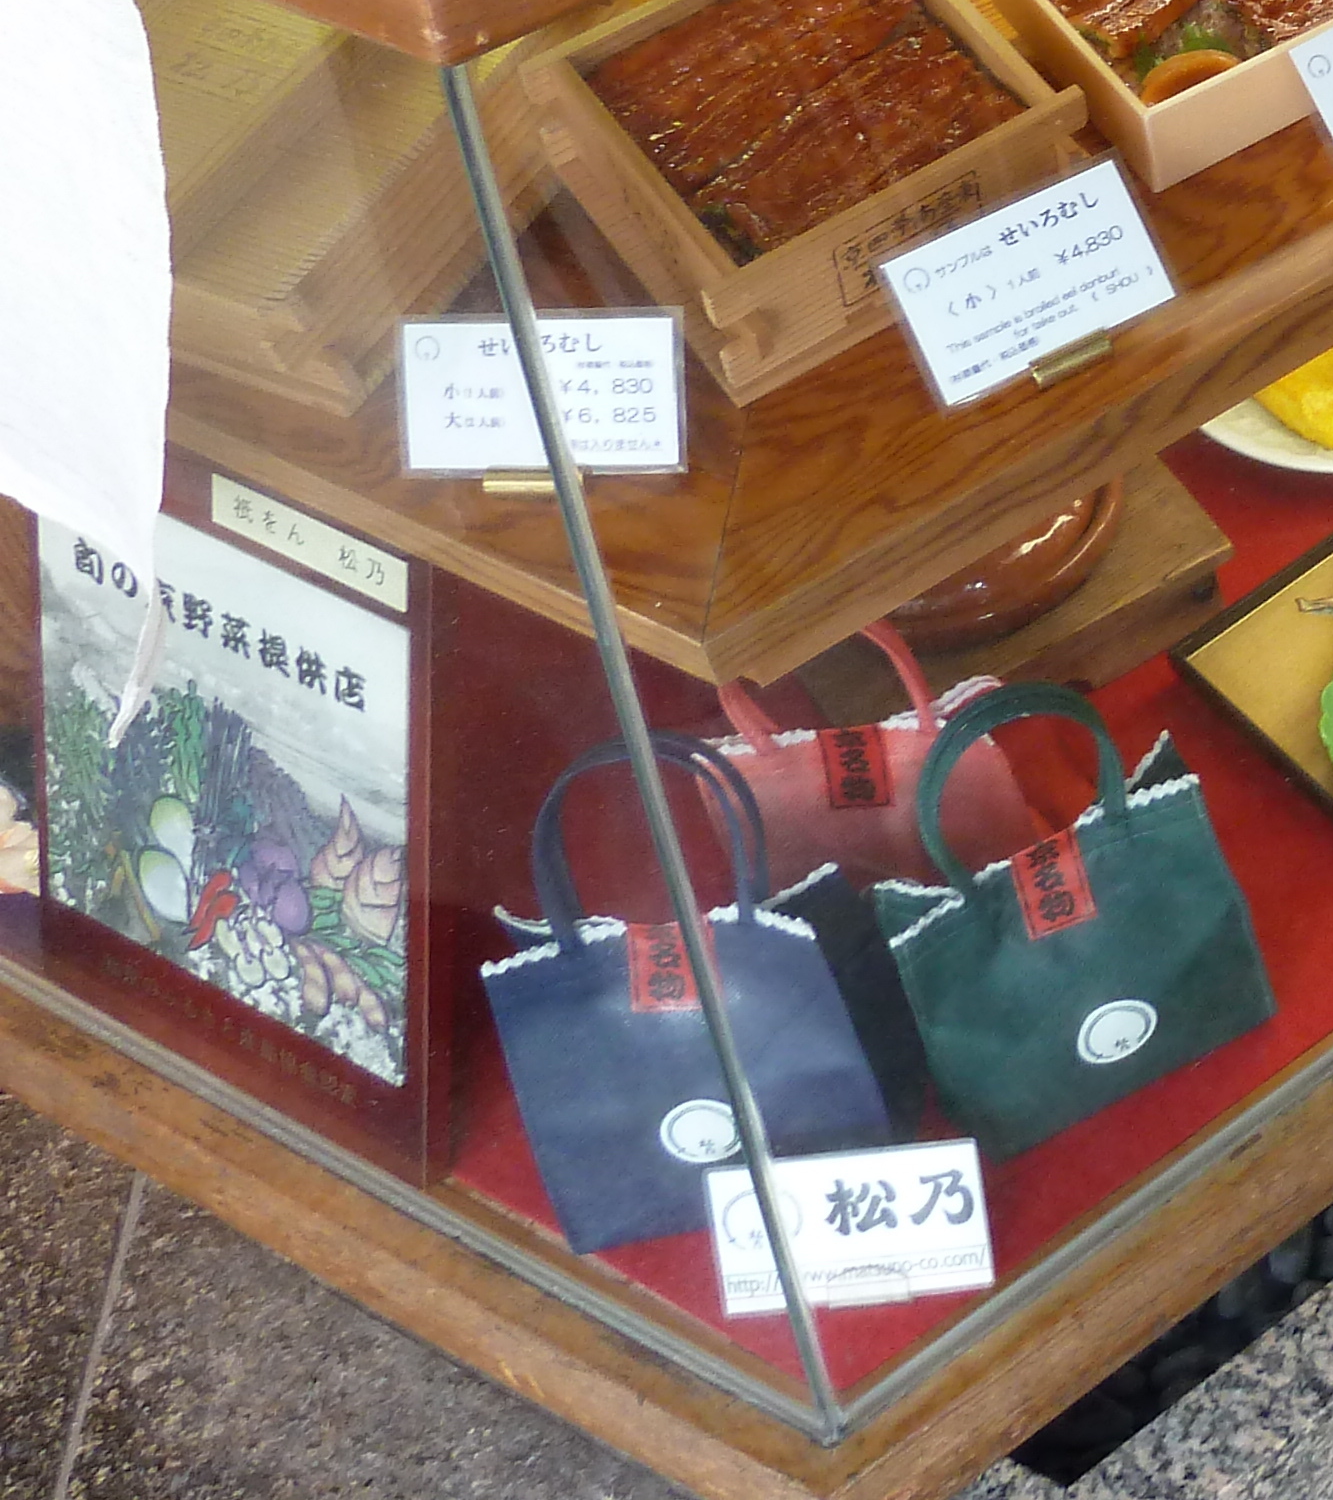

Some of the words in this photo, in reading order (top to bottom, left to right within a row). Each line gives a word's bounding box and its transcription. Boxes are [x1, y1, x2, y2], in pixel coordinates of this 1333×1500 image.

[998, 191, 1100, 247] せいろむし
[338, 545, 386, 587] 松乃
[825, 1169, 974, 1235] 松乃
